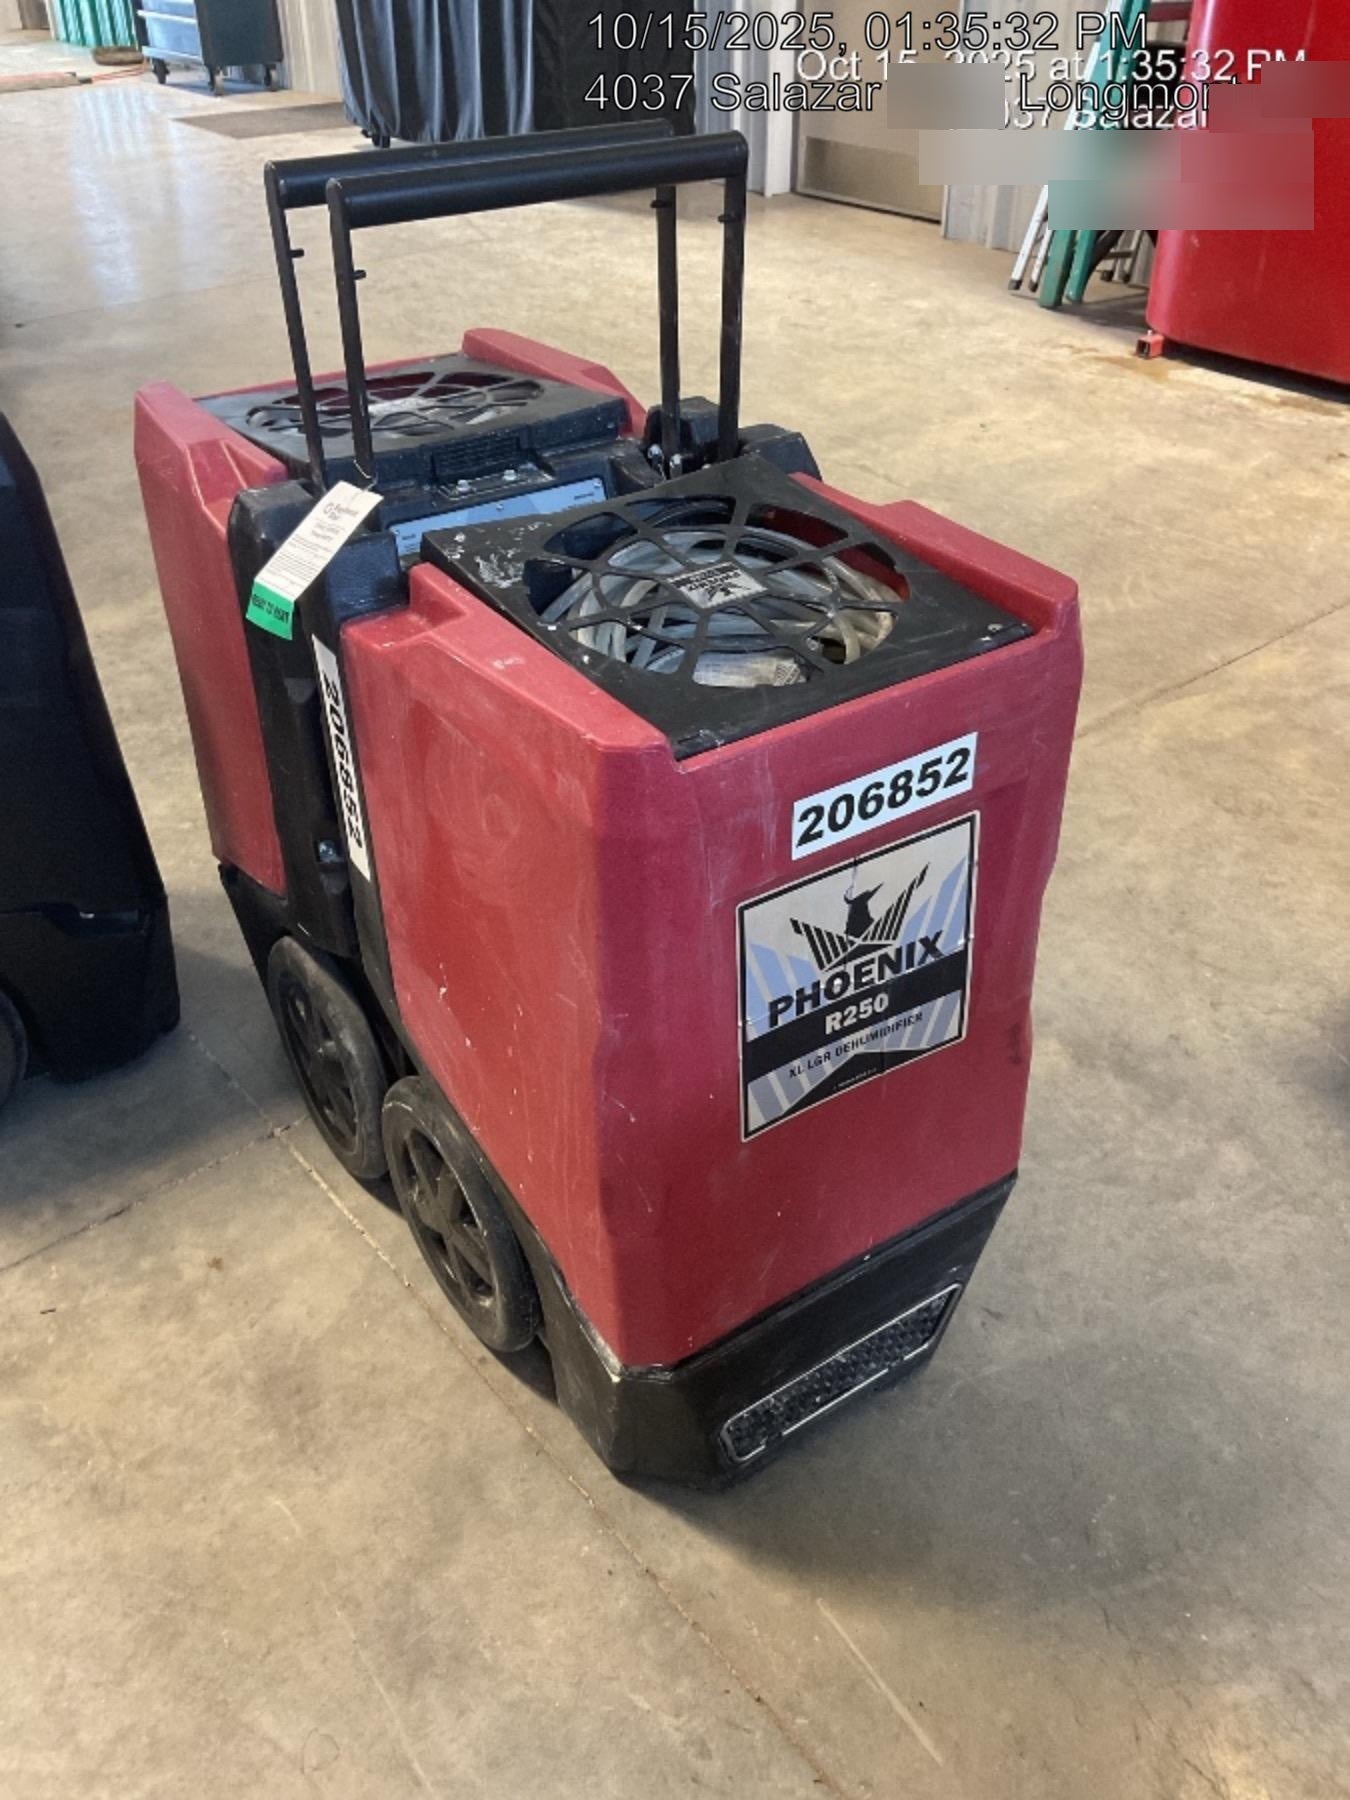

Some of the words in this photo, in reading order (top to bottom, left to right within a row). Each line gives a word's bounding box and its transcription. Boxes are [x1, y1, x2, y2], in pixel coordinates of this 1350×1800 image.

[797, 748, 971, 848] 206852
[767, 930, 947, 1029] PHOENIX
[824, 992, 889, 1035] R250
[807, 1051, 831, 1069] LGR
[835, 1012, 924, 1057] DEHUMIDIFIER
